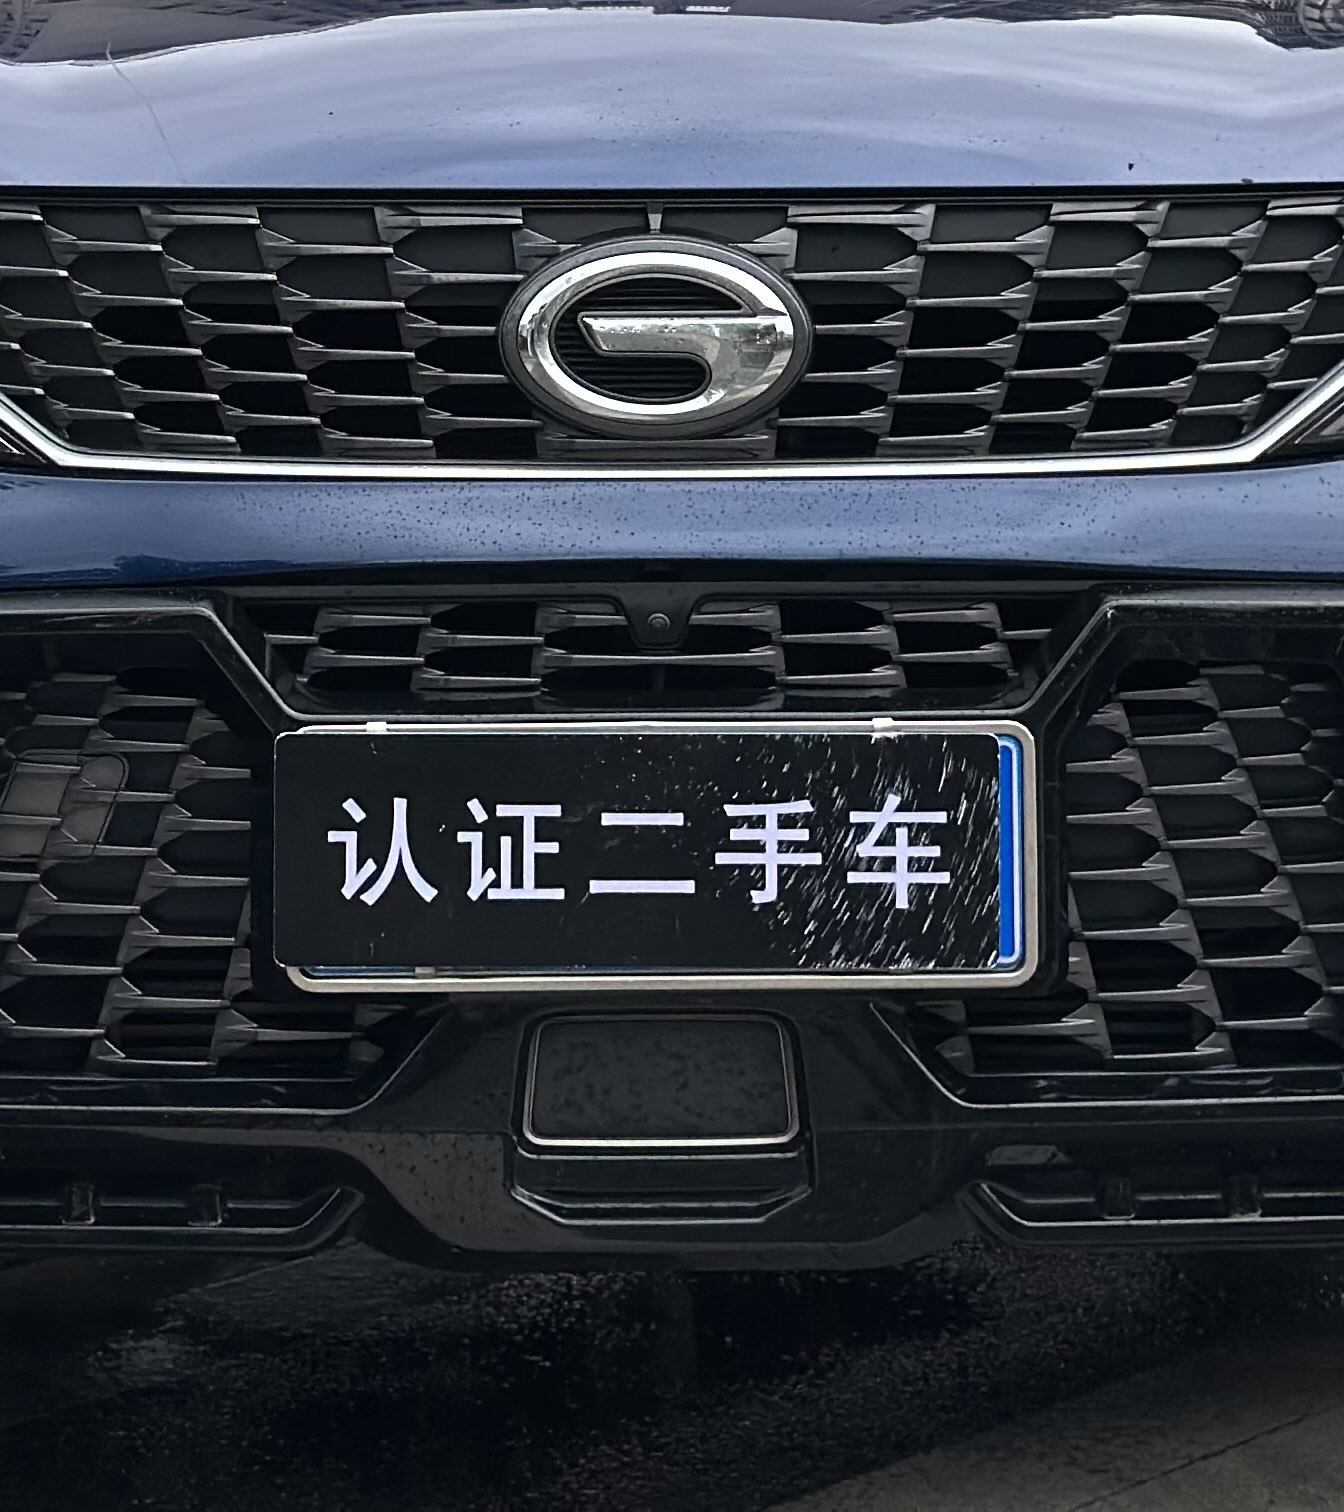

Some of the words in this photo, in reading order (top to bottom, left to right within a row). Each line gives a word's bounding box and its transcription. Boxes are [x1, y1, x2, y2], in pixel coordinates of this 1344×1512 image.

[327, 794, 951, 909] 认证二手车
